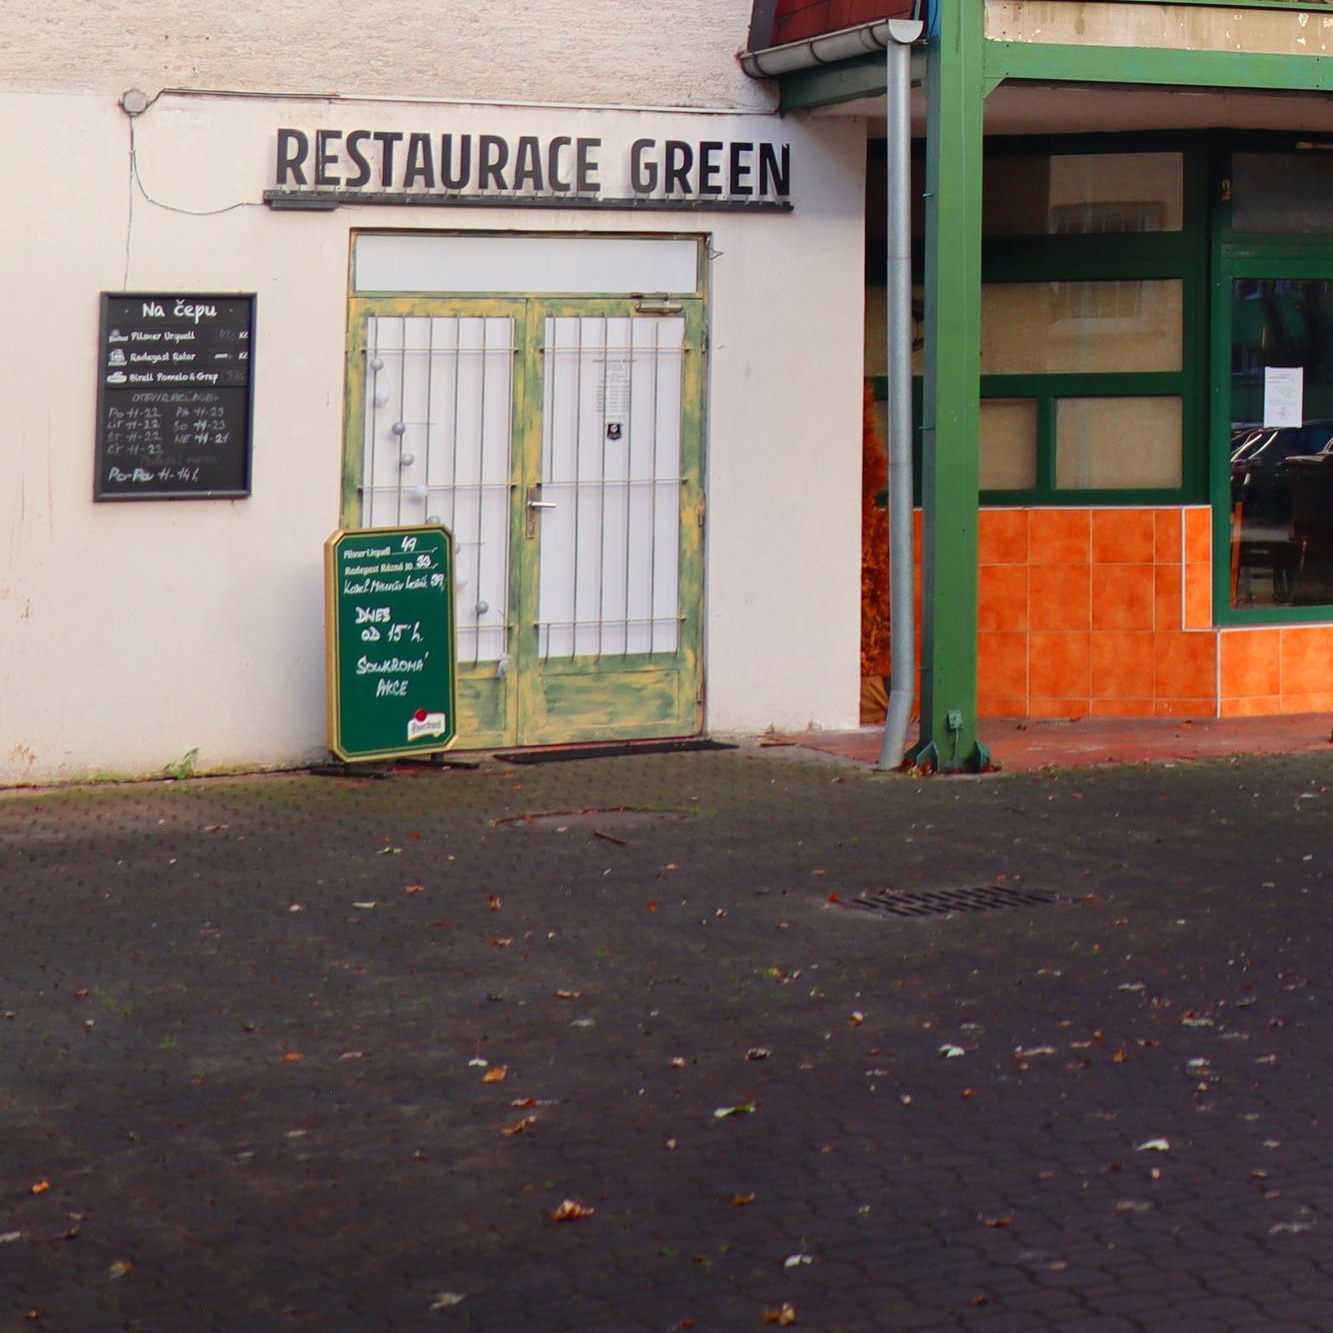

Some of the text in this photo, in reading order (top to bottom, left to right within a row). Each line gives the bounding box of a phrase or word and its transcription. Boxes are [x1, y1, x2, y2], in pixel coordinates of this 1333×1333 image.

[276, 128, 790, 196] RESTAURACE GREEN
[142, 299, 217, 324] Na čepu
[131, 331, 162, 341] Pilsner
[164, 331, 195, 344] Urquell
[130, 352, 169, 363] Radegast
[129, 373, 153, 382] Birell
[156, 373, 188, 381] Pomelo
[197, 372, 218, 384] Grep
[345, 565, 379, 576] Radegast
[355, 606, 391, 624] DNES
